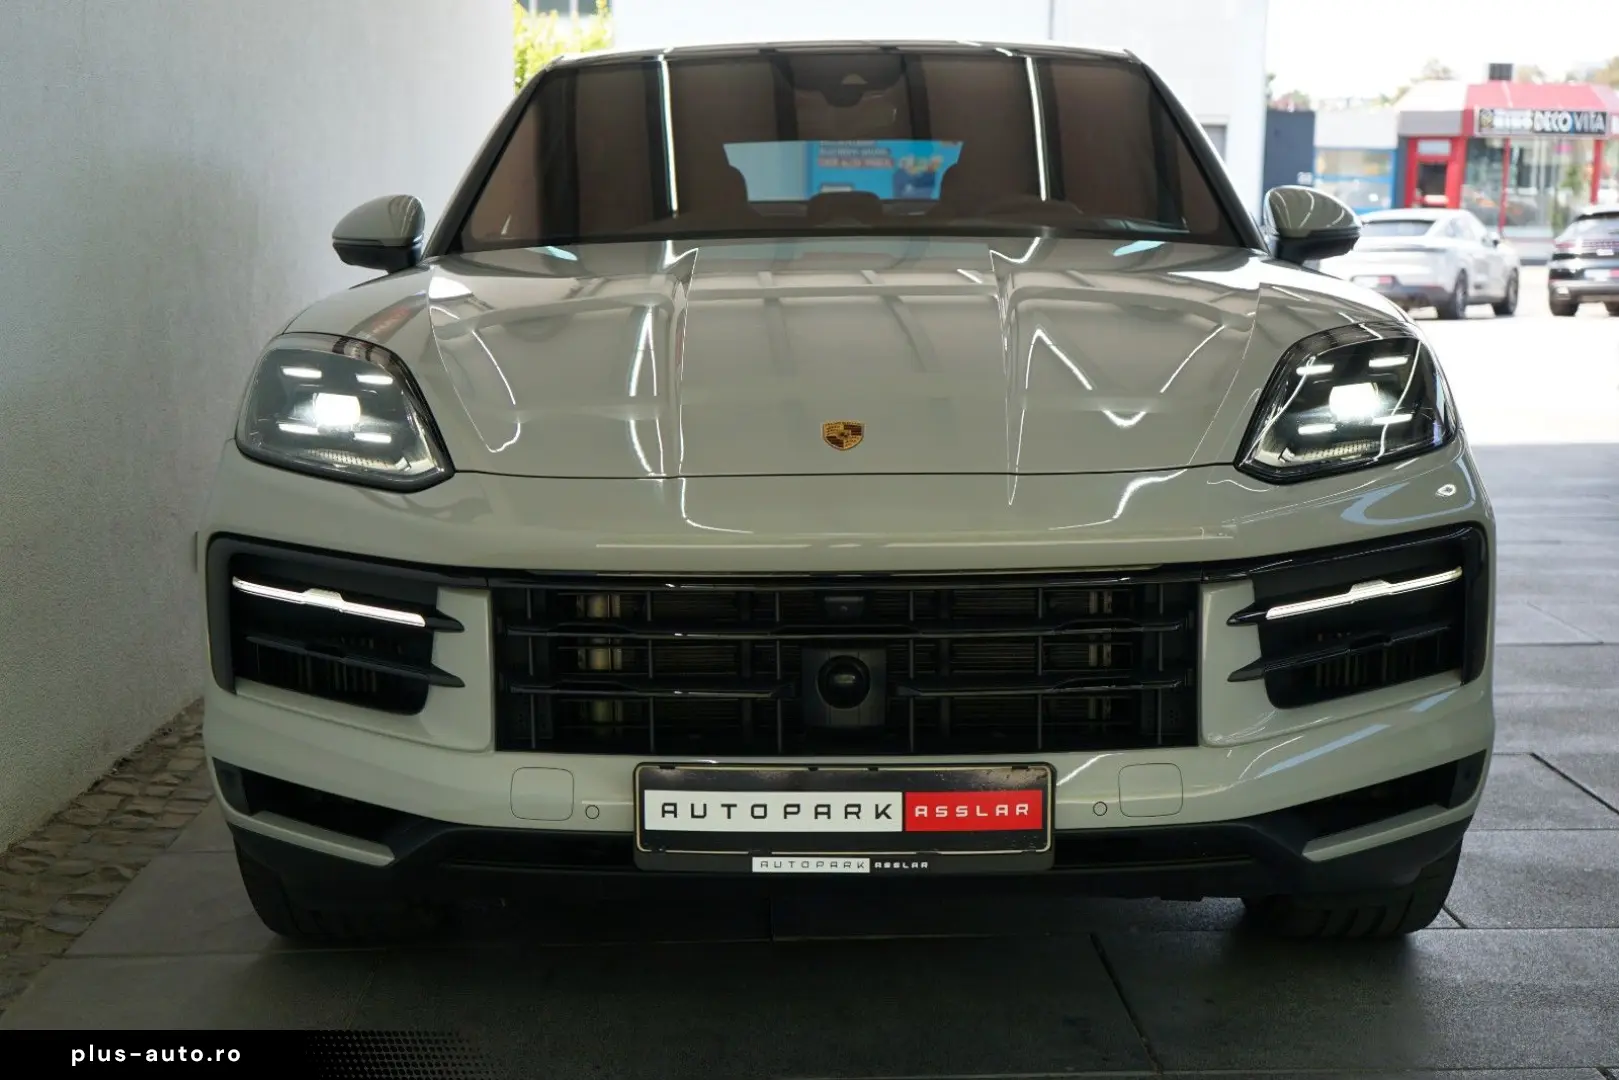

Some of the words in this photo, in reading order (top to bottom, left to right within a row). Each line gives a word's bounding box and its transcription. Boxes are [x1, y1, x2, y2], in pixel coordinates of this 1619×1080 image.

[661, 802, 892, 820] AUTOPARK
[914, 803, 1030, 818] ASSLAR
[759, 859, 865, 870] AUTOPARK
[873, 860, 930, 870] ASSLAR
